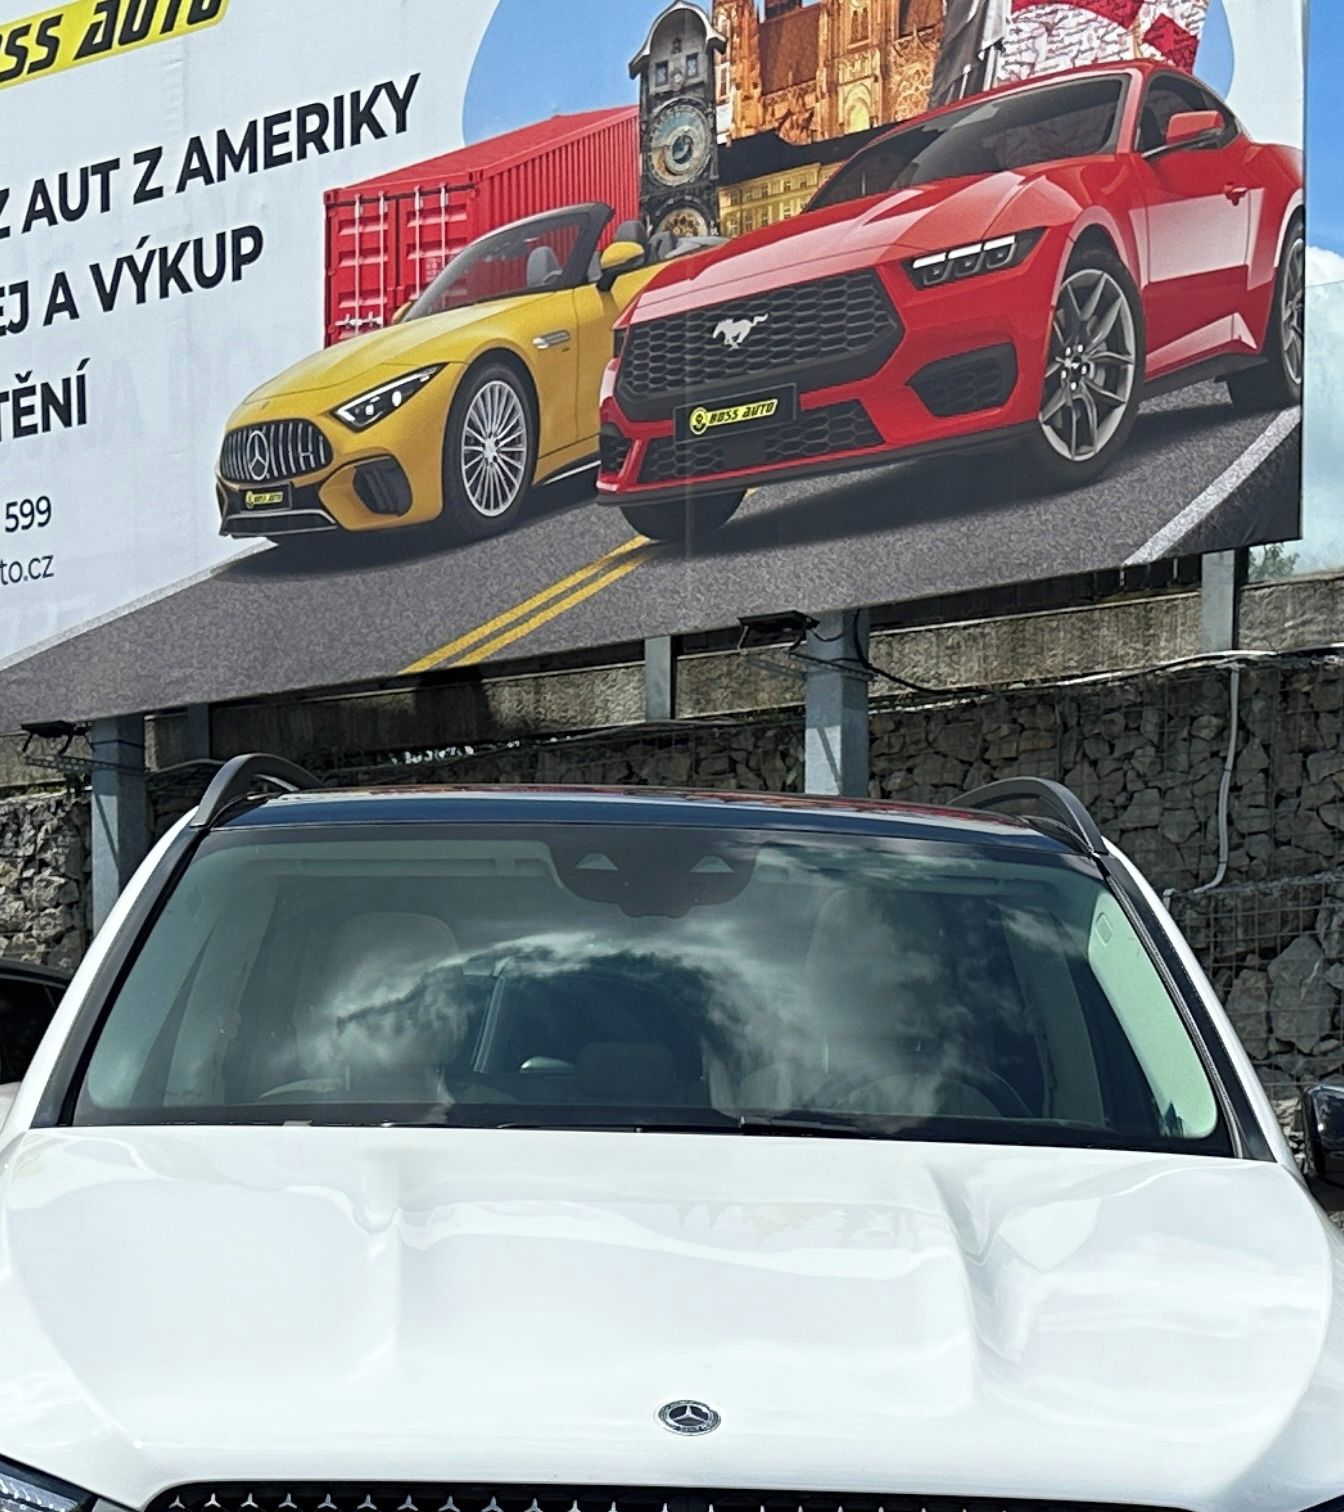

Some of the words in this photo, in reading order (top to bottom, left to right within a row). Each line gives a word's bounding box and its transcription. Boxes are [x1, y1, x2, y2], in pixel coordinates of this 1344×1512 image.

[21, 157, 121, 235] AUT
[133, 146, 164, 206] Z
[175, 71, 422, 194] AMERIKY
[42, 271, 80, 327] A
[88, 224, 264, 313] VÝKUP
[5, 495, 53, 534] 599
